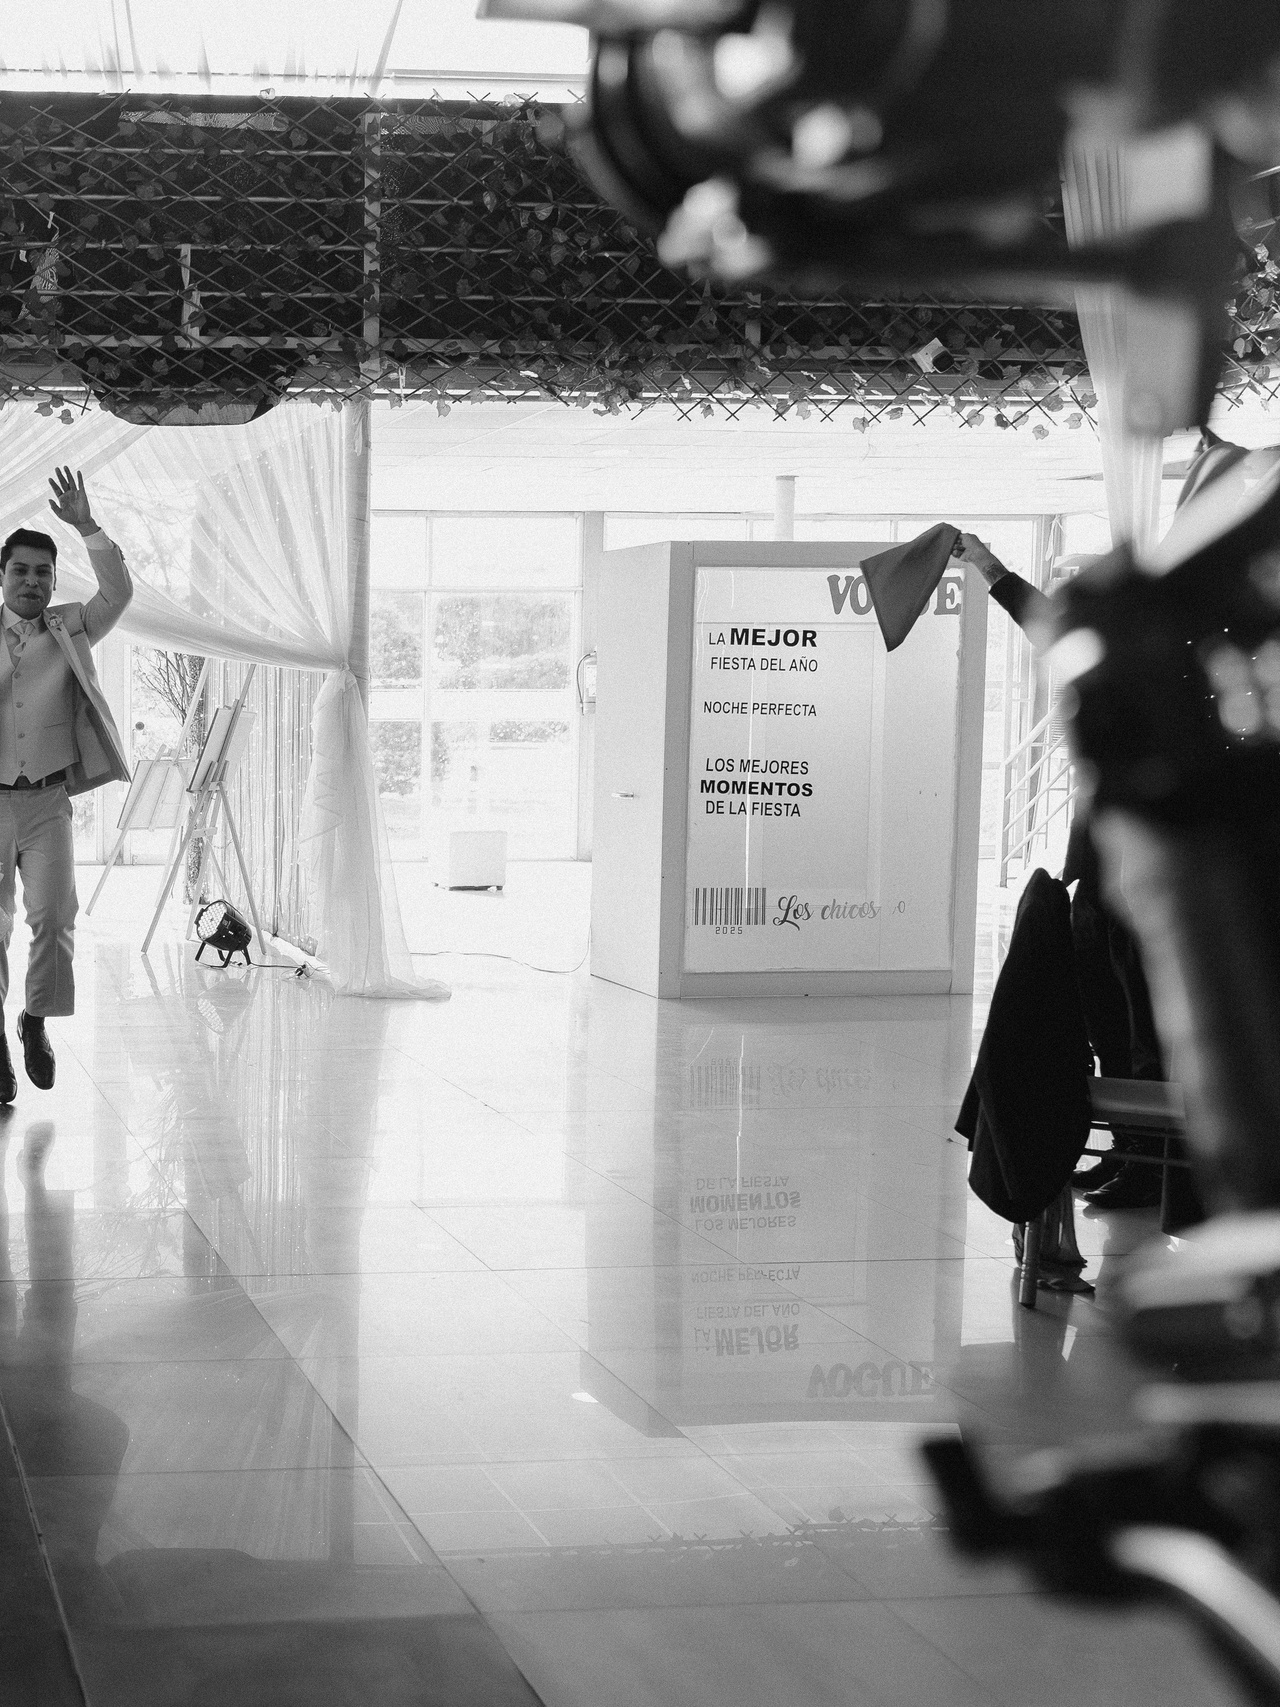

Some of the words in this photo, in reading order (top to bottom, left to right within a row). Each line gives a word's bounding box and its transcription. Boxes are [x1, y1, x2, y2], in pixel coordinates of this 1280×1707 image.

[827, 574, 963, 616] VOE
[708, 632, 726, 645] LA
[729, 627, 817, 648] MEJOR
[710, 656, 757, 671] FIESTA
[760, 657, 786, 671] DEL
[789, 655, 818, 672] AÑO
[703, 701, 749, 715] NOCHE
[751, 702, 817, 717] PERFECTA
[705, 757, 735, 773] LOS
[739, 758, 809, 775] MEJORES
[700, 779, 813, 797] MOMENTOS
[705, 800, 725, 815] DE
[729, 801, 747, 816] LA
[751, 801, 801, 817] FIESTA
[772, 894, 814, 931] Los
[821, 898, 880, 920] chicos
[715, 926, 743, 935] 2025
